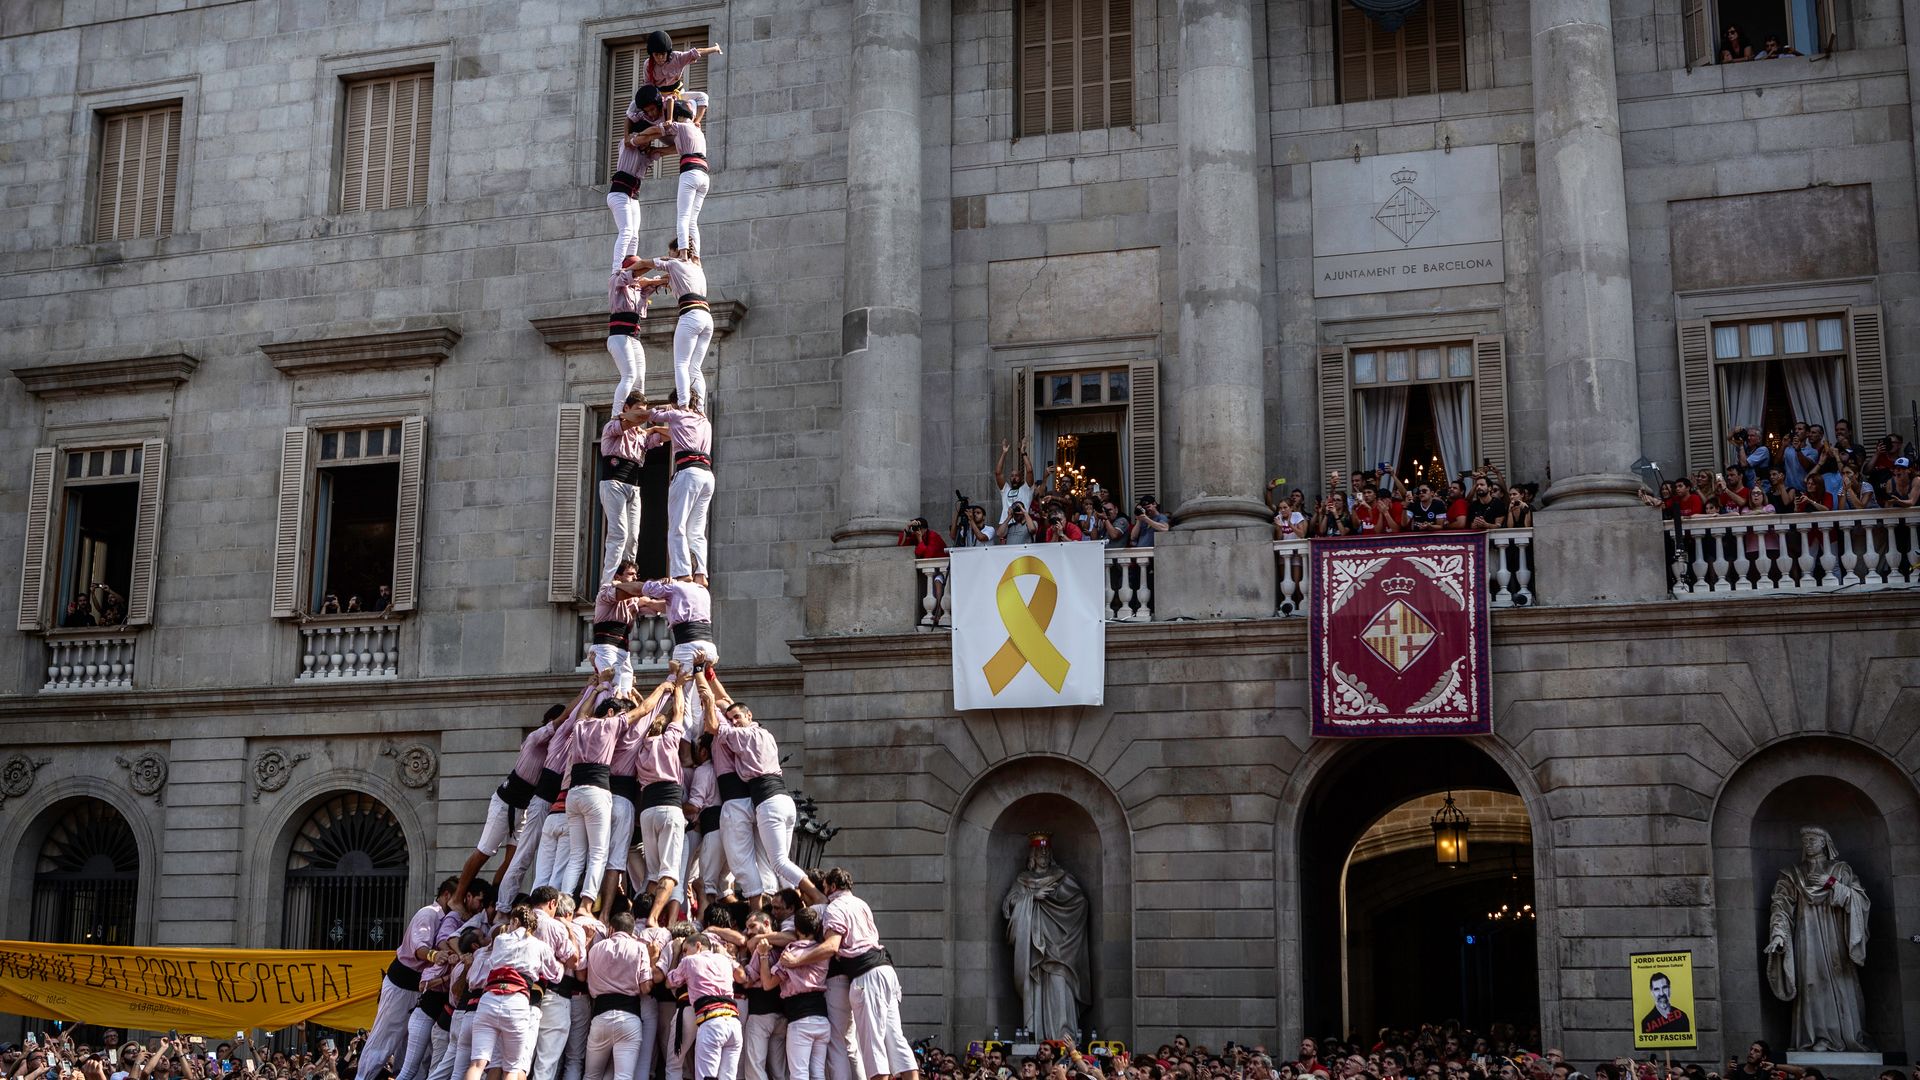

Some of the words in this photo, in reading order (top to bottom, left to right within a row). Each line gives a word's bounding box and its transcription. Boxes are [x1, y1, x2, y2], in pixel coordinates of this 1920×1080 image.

[1324, 266, 1397, 281] AJUNTAMENT
[1402, 264, 1417, 275] DE
[1423, 258, 1493, 273] BARCELONA
[1656, 955, 1687, 963] CUIXART
[210, 960, 353, 1004] RESPECTAT
[1645, 1009, 1682, 1032] JAILED
[1639, 1034, 1658, 1042] STOP
[1660, 1033, 1693, 1041] FASCISM
